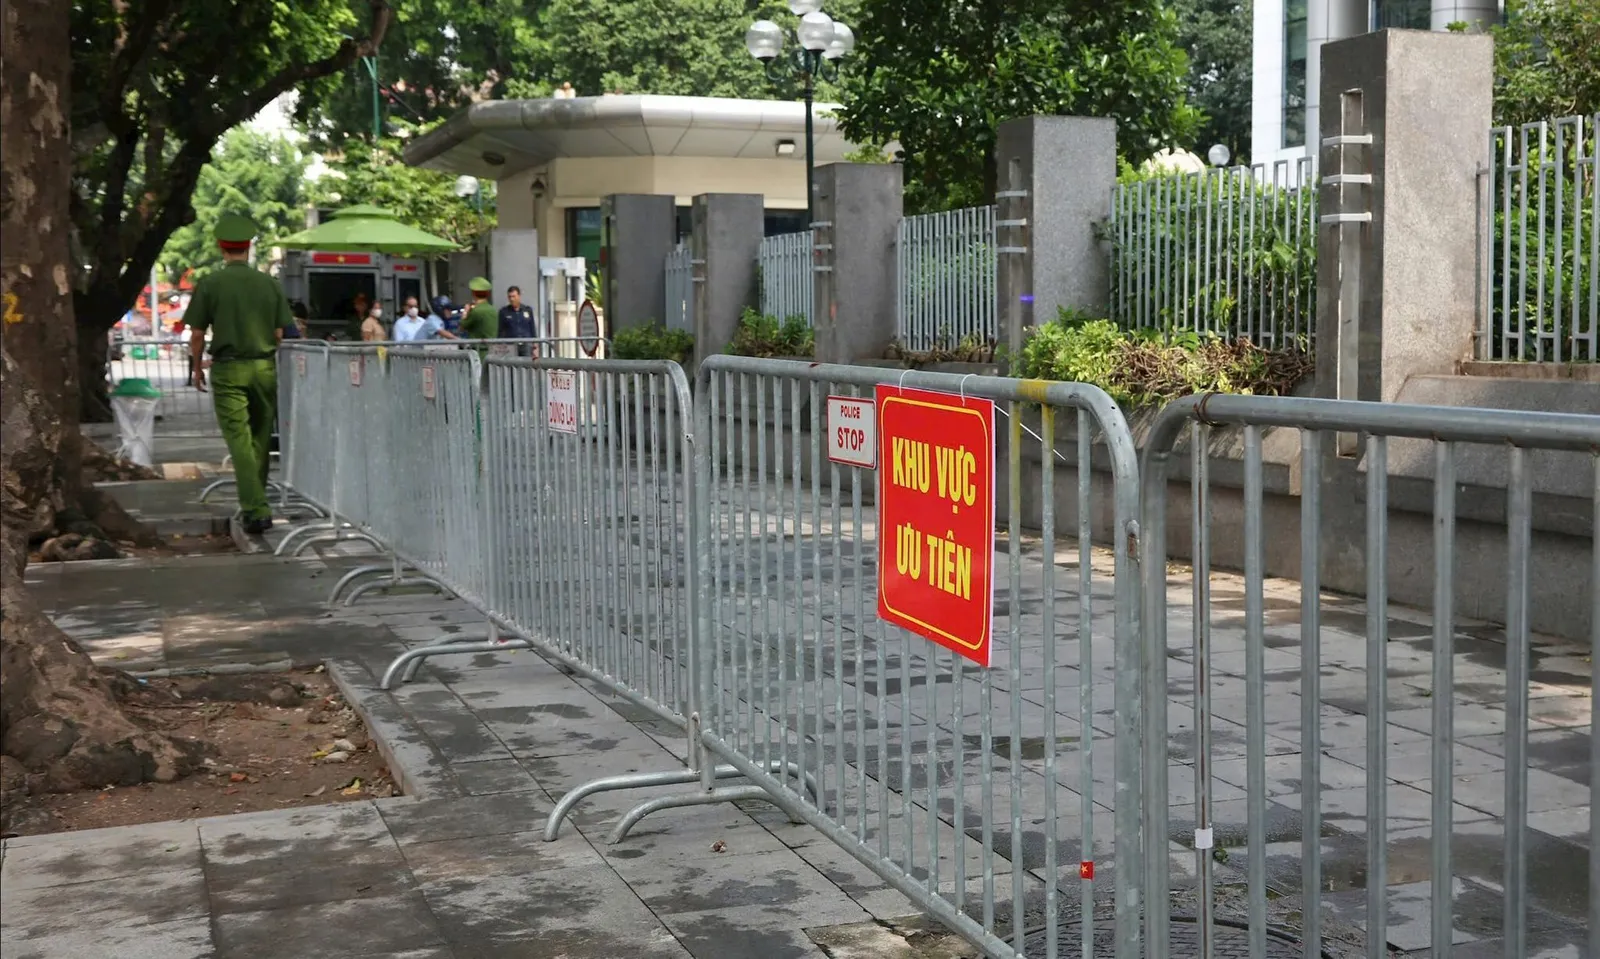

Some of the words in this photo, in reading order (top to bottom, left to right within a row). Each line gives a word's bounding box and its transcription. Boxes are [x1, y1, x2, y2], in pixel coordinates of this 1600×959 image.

[840, 405, 861, 419] POLICE
[837, 426, 865, 451] STOP
[892, 436, 930, 494] KHU
[935, 445, 976, 515] VỰC
[896, 522, 922, 581] ƯU
[927, 530, 972, 601] TIÊN
